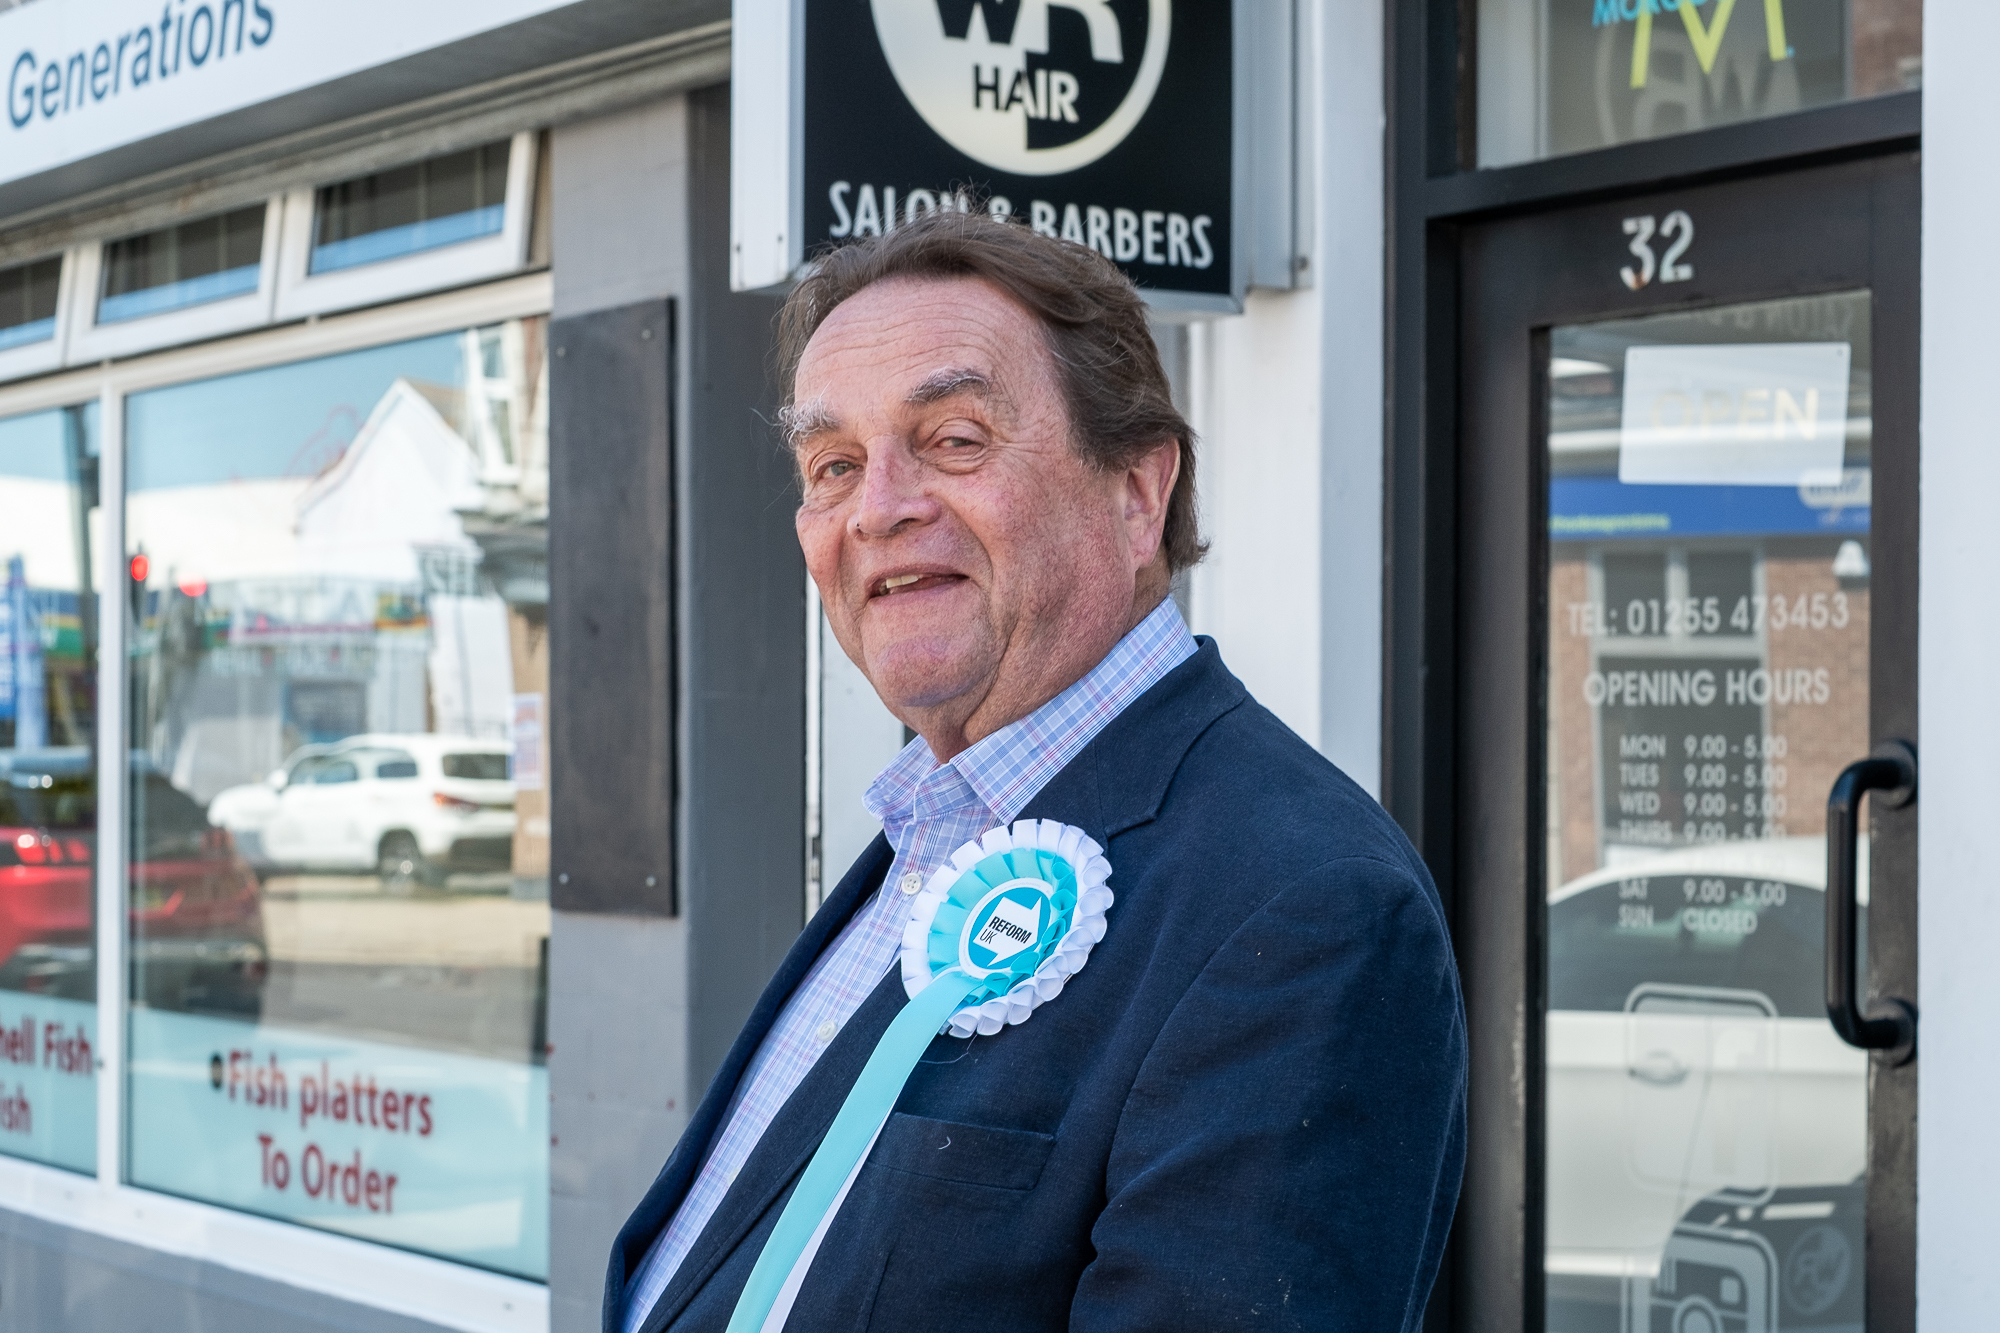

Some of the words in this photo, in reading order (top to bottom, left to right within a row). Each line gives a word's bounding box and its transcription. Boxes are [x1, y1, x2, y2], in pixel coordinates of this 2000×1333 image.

[9, 0, 274, 128] Generations
[973, 63, 1081, 124] HAIR
[1030, 199, 1214, 270] BARBERS
[1619, 210, 1694, 290] 32
[1650, 387, 1819, 441] OPEN
[1567, 600, 1618, 638] TEL:
[1626, 597, 1720, 635] 01255
[1729, 591, 1850, 632] 473453
[1583, 669, 1717, 707] OPENING
[1725, 667, 1831, 706] HOURS
[1619, 734, 1667, 759] MON
[1682, 734, 1727, 759] 9.00
[1619, 762, 1660, 787] TUES
[1682, 763, 1727, 788] 9.00
[1618, 790, 1662, 816] WED
[1682, 792, 1727, 817] 9.00
[979, 928, 998, 945] UK
[989, 915, 1033, 944] REFORM
[1618, 902, 1654, 929] SUN
[1682, 906, 1759, 935] CLOSED
[43, 1020, 94, 1077] Fish
[228, 1048, 288, 1112] Fish
[300, 1057, 434, 1139] platters
[258, 1133, 291, 1190] To
[302, 1142, 398, 1215] Order
